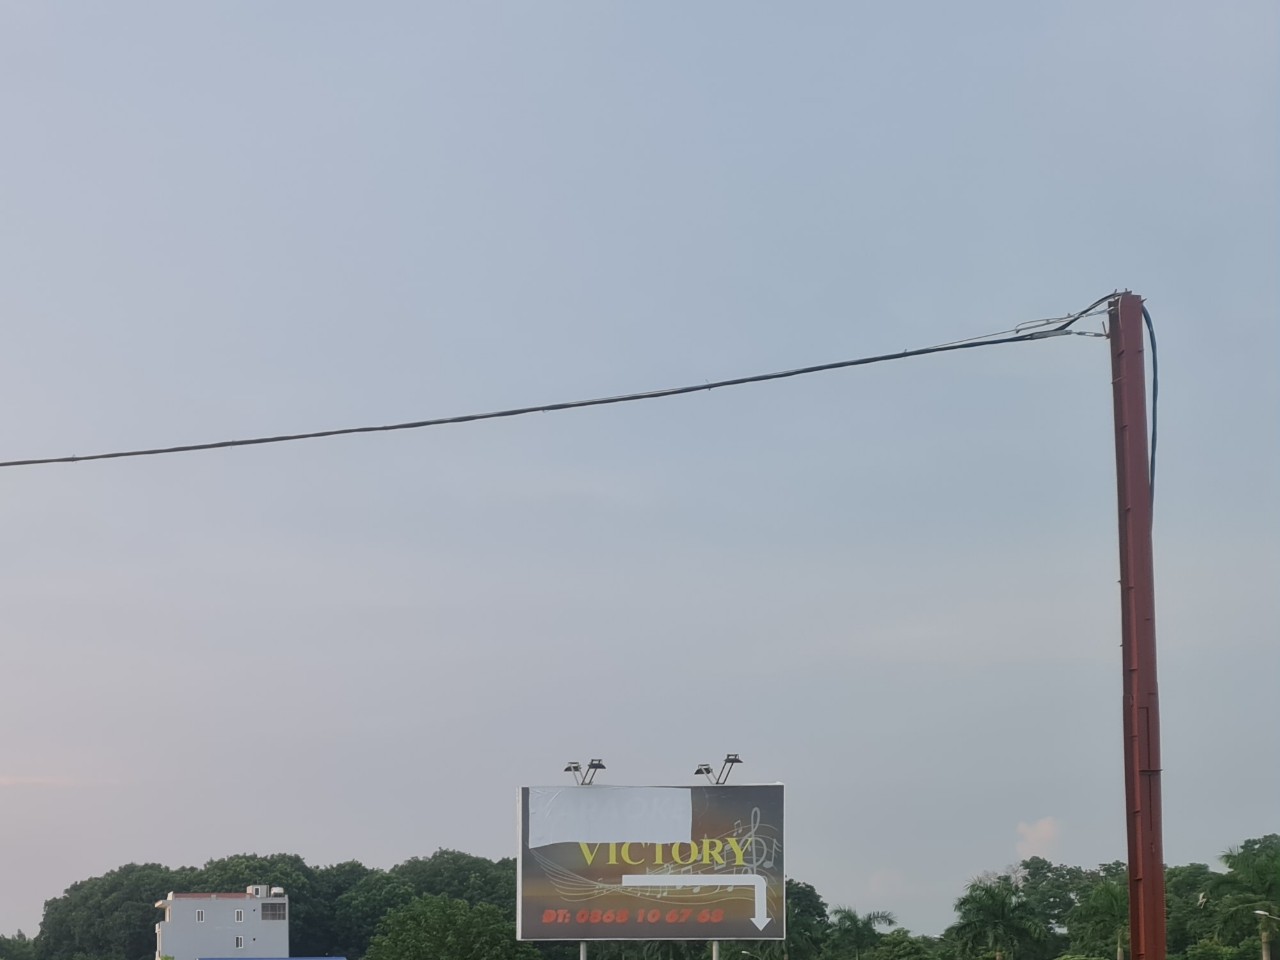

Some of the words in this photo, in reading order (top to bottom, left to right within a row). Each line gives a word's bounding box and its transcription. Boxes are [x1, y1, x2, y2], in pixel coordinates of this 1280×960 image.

[578, 837, 752, 866] VICTORY
[636, 909, 661, 923] 10
[665, 909, 692, 923] 67
